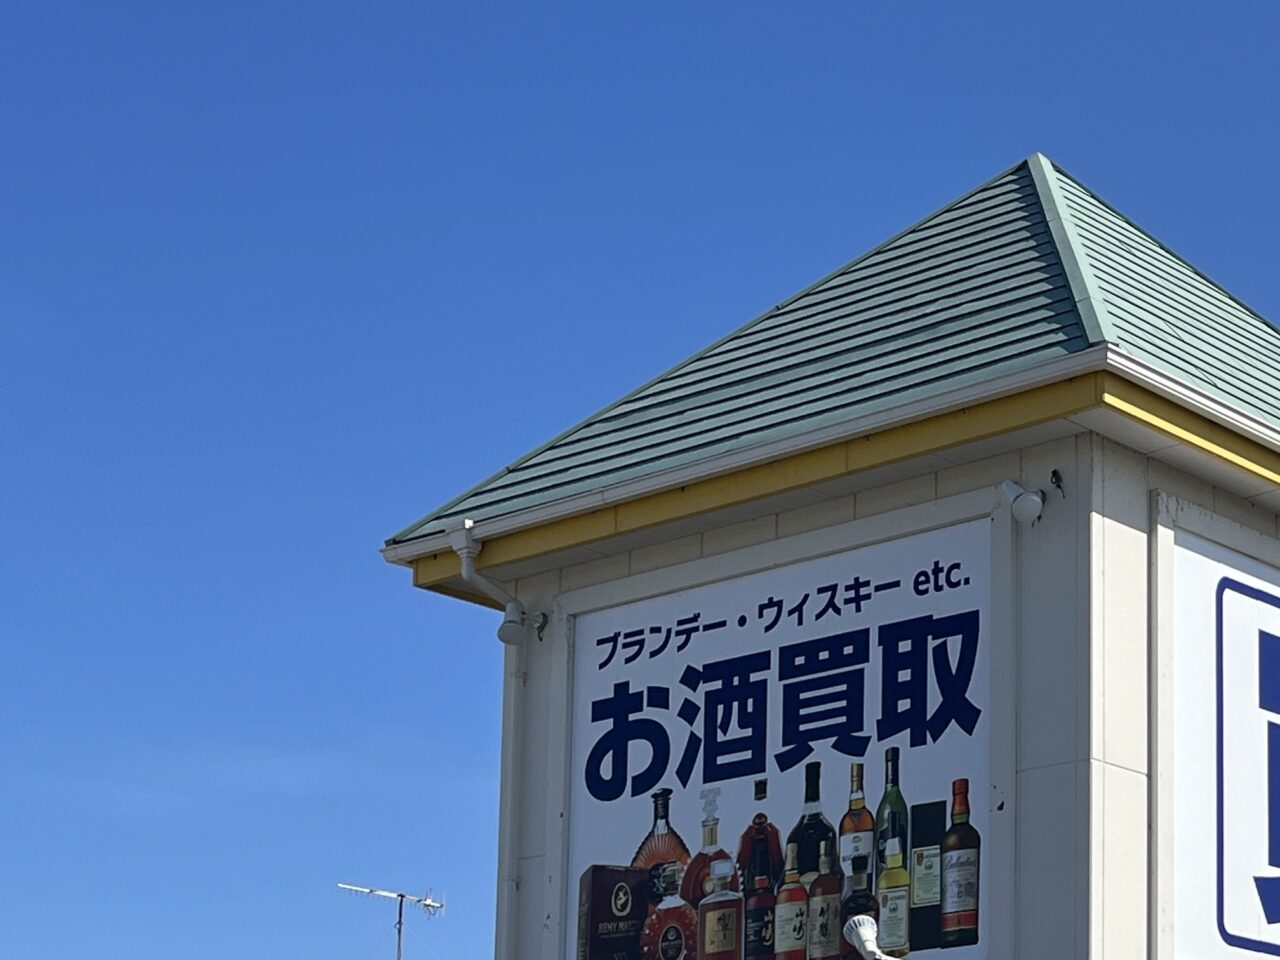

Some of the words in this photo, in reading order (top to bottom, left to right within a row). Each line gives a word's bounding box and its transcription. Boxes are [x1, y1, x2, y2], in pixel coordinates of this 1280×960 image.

[596, 577, 901, 670] ブランデー・ウィスキー
[913, 560, 971, 596] etc.
[584, 610, 982, 802] お酒買取
